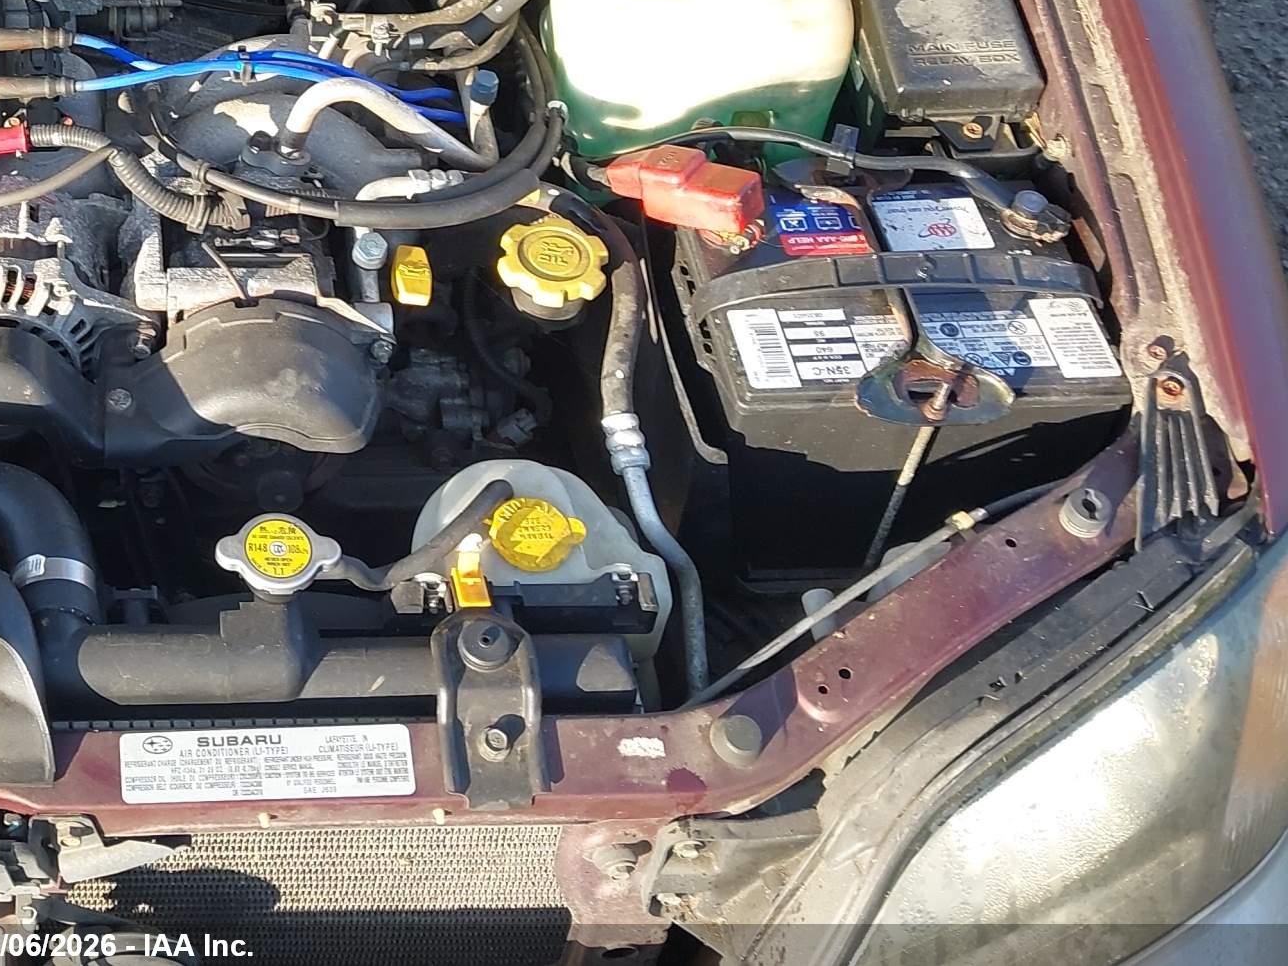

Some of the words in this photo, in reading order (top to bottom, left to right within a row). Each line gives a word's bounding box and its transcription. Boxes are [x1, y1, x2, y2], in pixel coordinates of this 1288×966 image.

[908, 42, 960, 53] MAIN
[964, 40, 1016, 50] FUSE
[912, 56, 973, 66] RELAY
[978, 53, 1022, 64] BOX
[811, 366, 852, 376] 35N-C
[197, 735, 282, 747] SUBARU
[179, 749, 193, 758] AIR
[195, 747, 250, 758] CONDITIONER
